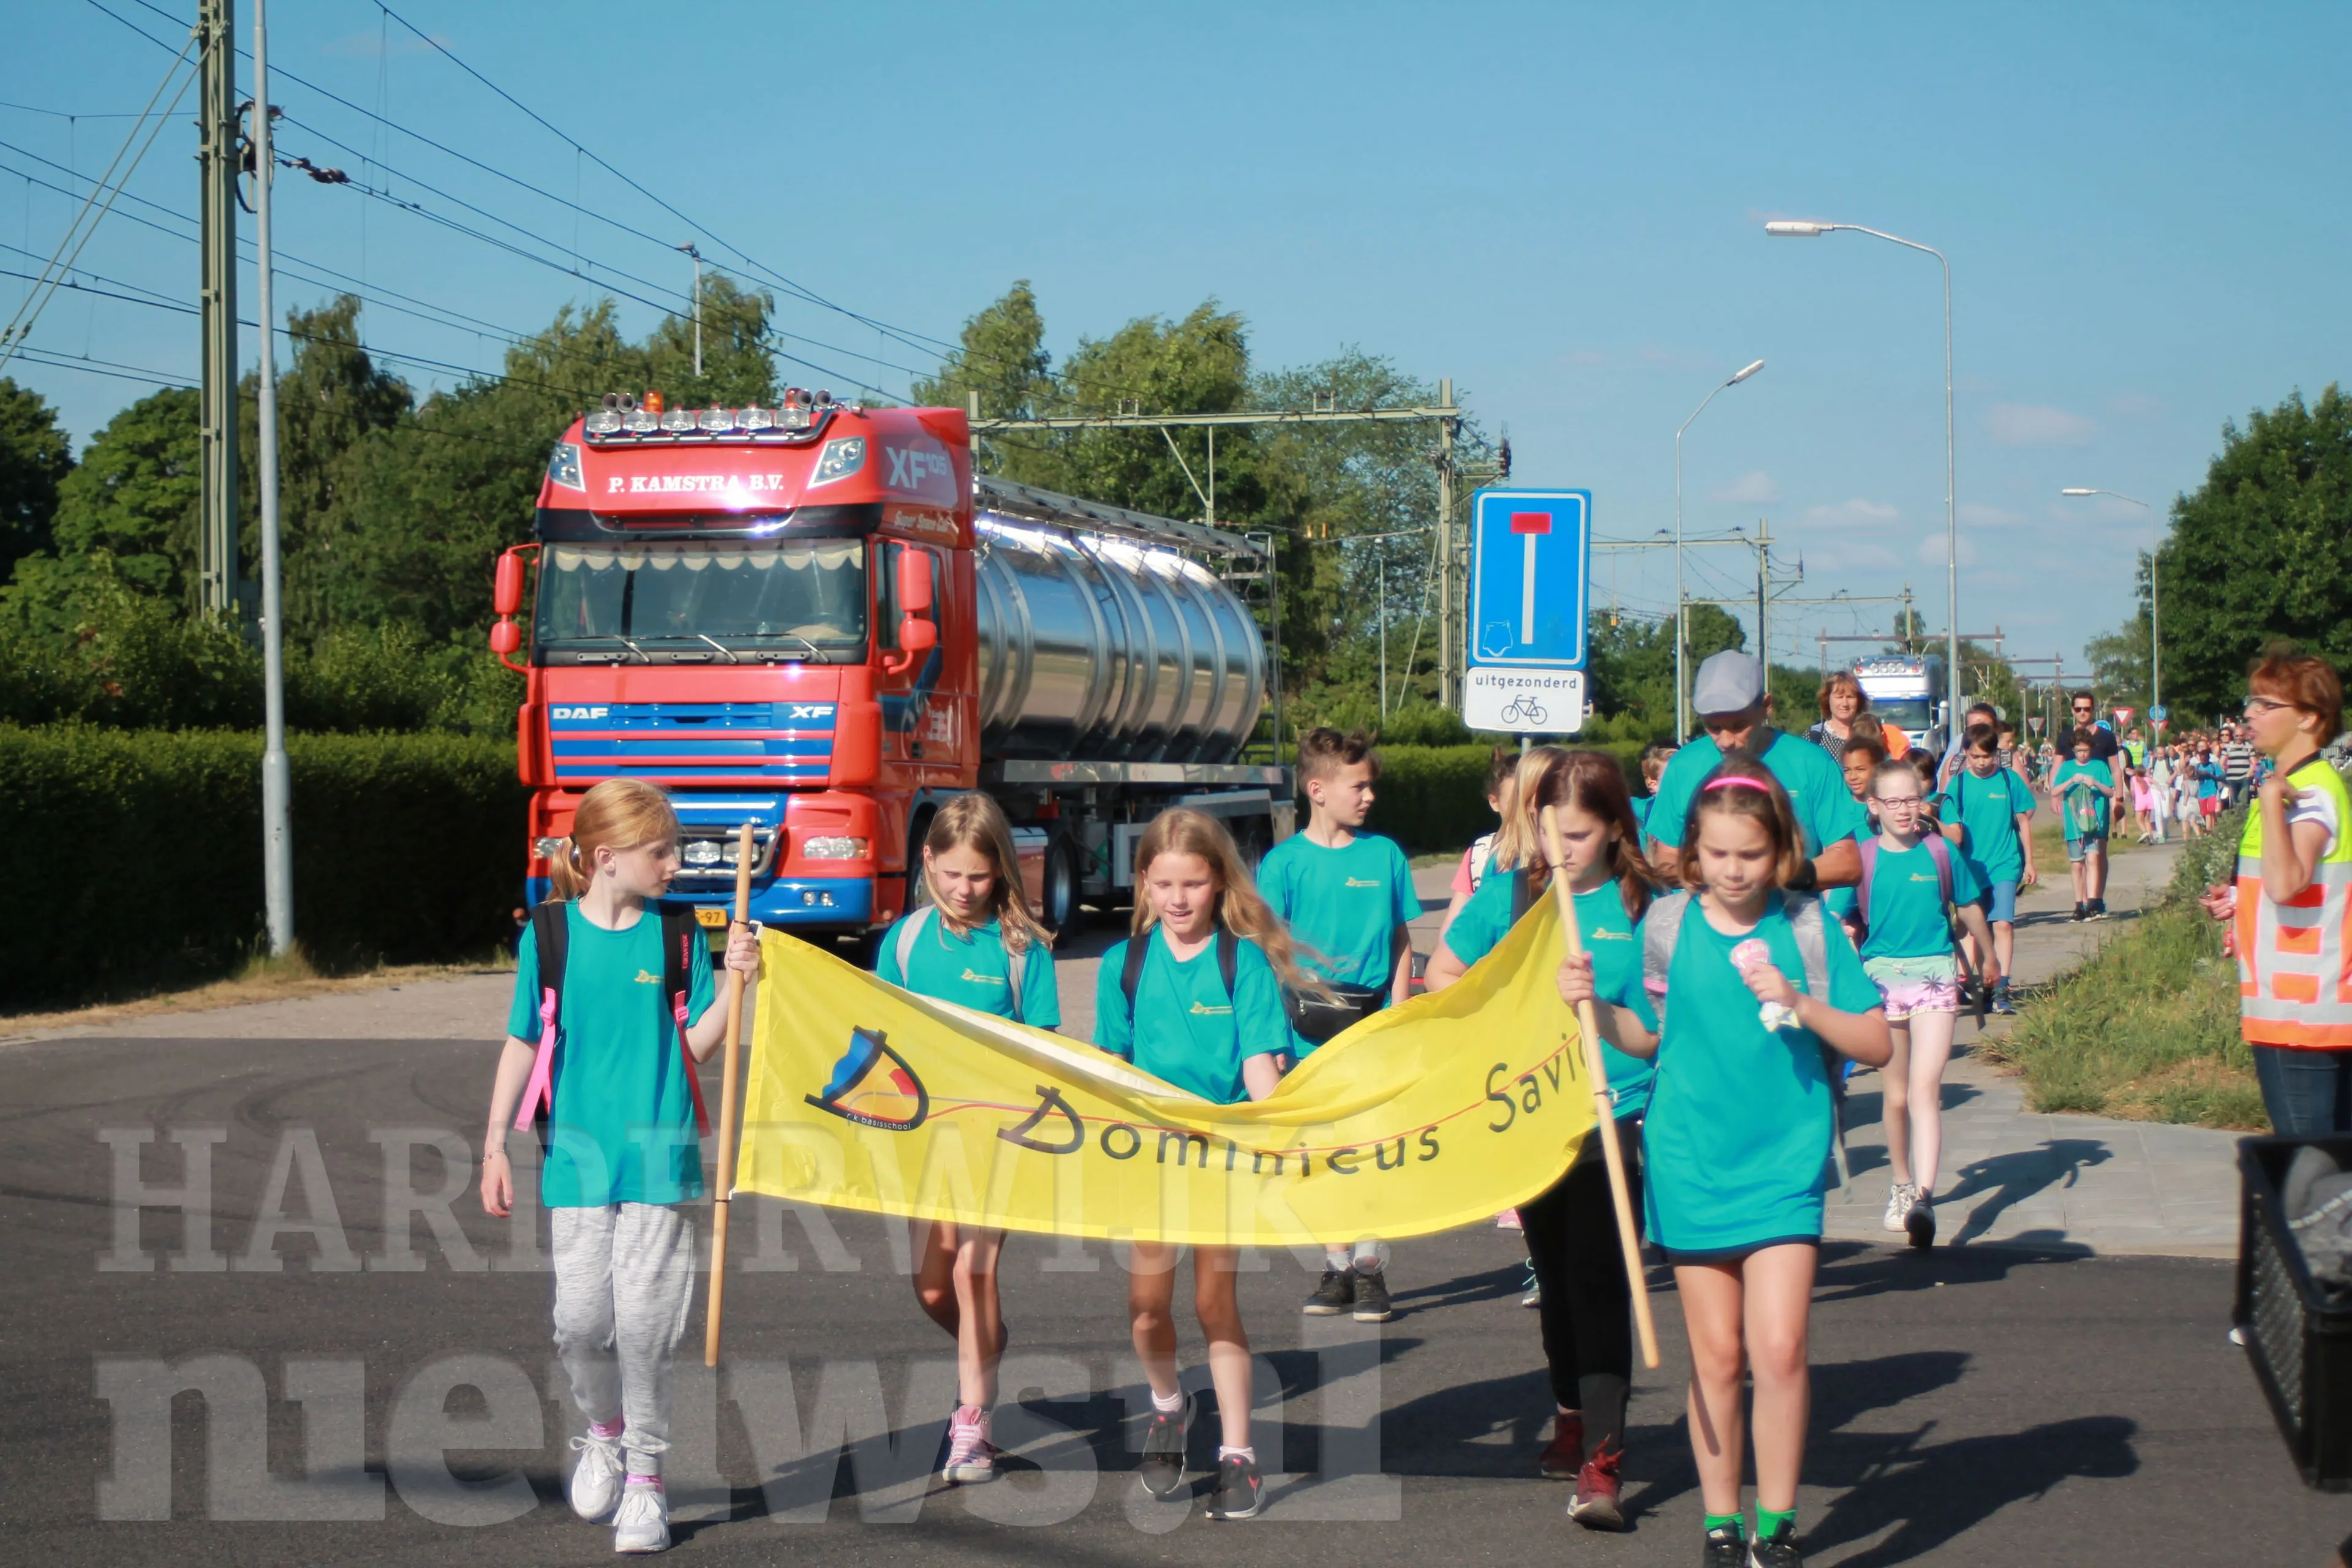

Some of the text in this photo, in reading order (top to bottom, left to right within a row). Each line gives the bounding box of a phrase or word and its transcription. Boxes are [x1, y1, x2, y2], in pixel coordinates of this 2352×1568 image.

[608, 474, 784, 492] P. KAMSTRA B.V.
[1475, 675, 1577, 690] uitgezonderd
[552, 706, 609, 720] DAF
[788, 706, 834, 718] XF
[861, 1117, 912, 1131] basisschool
[997, 1084, 1441, 1178] Dominicus
